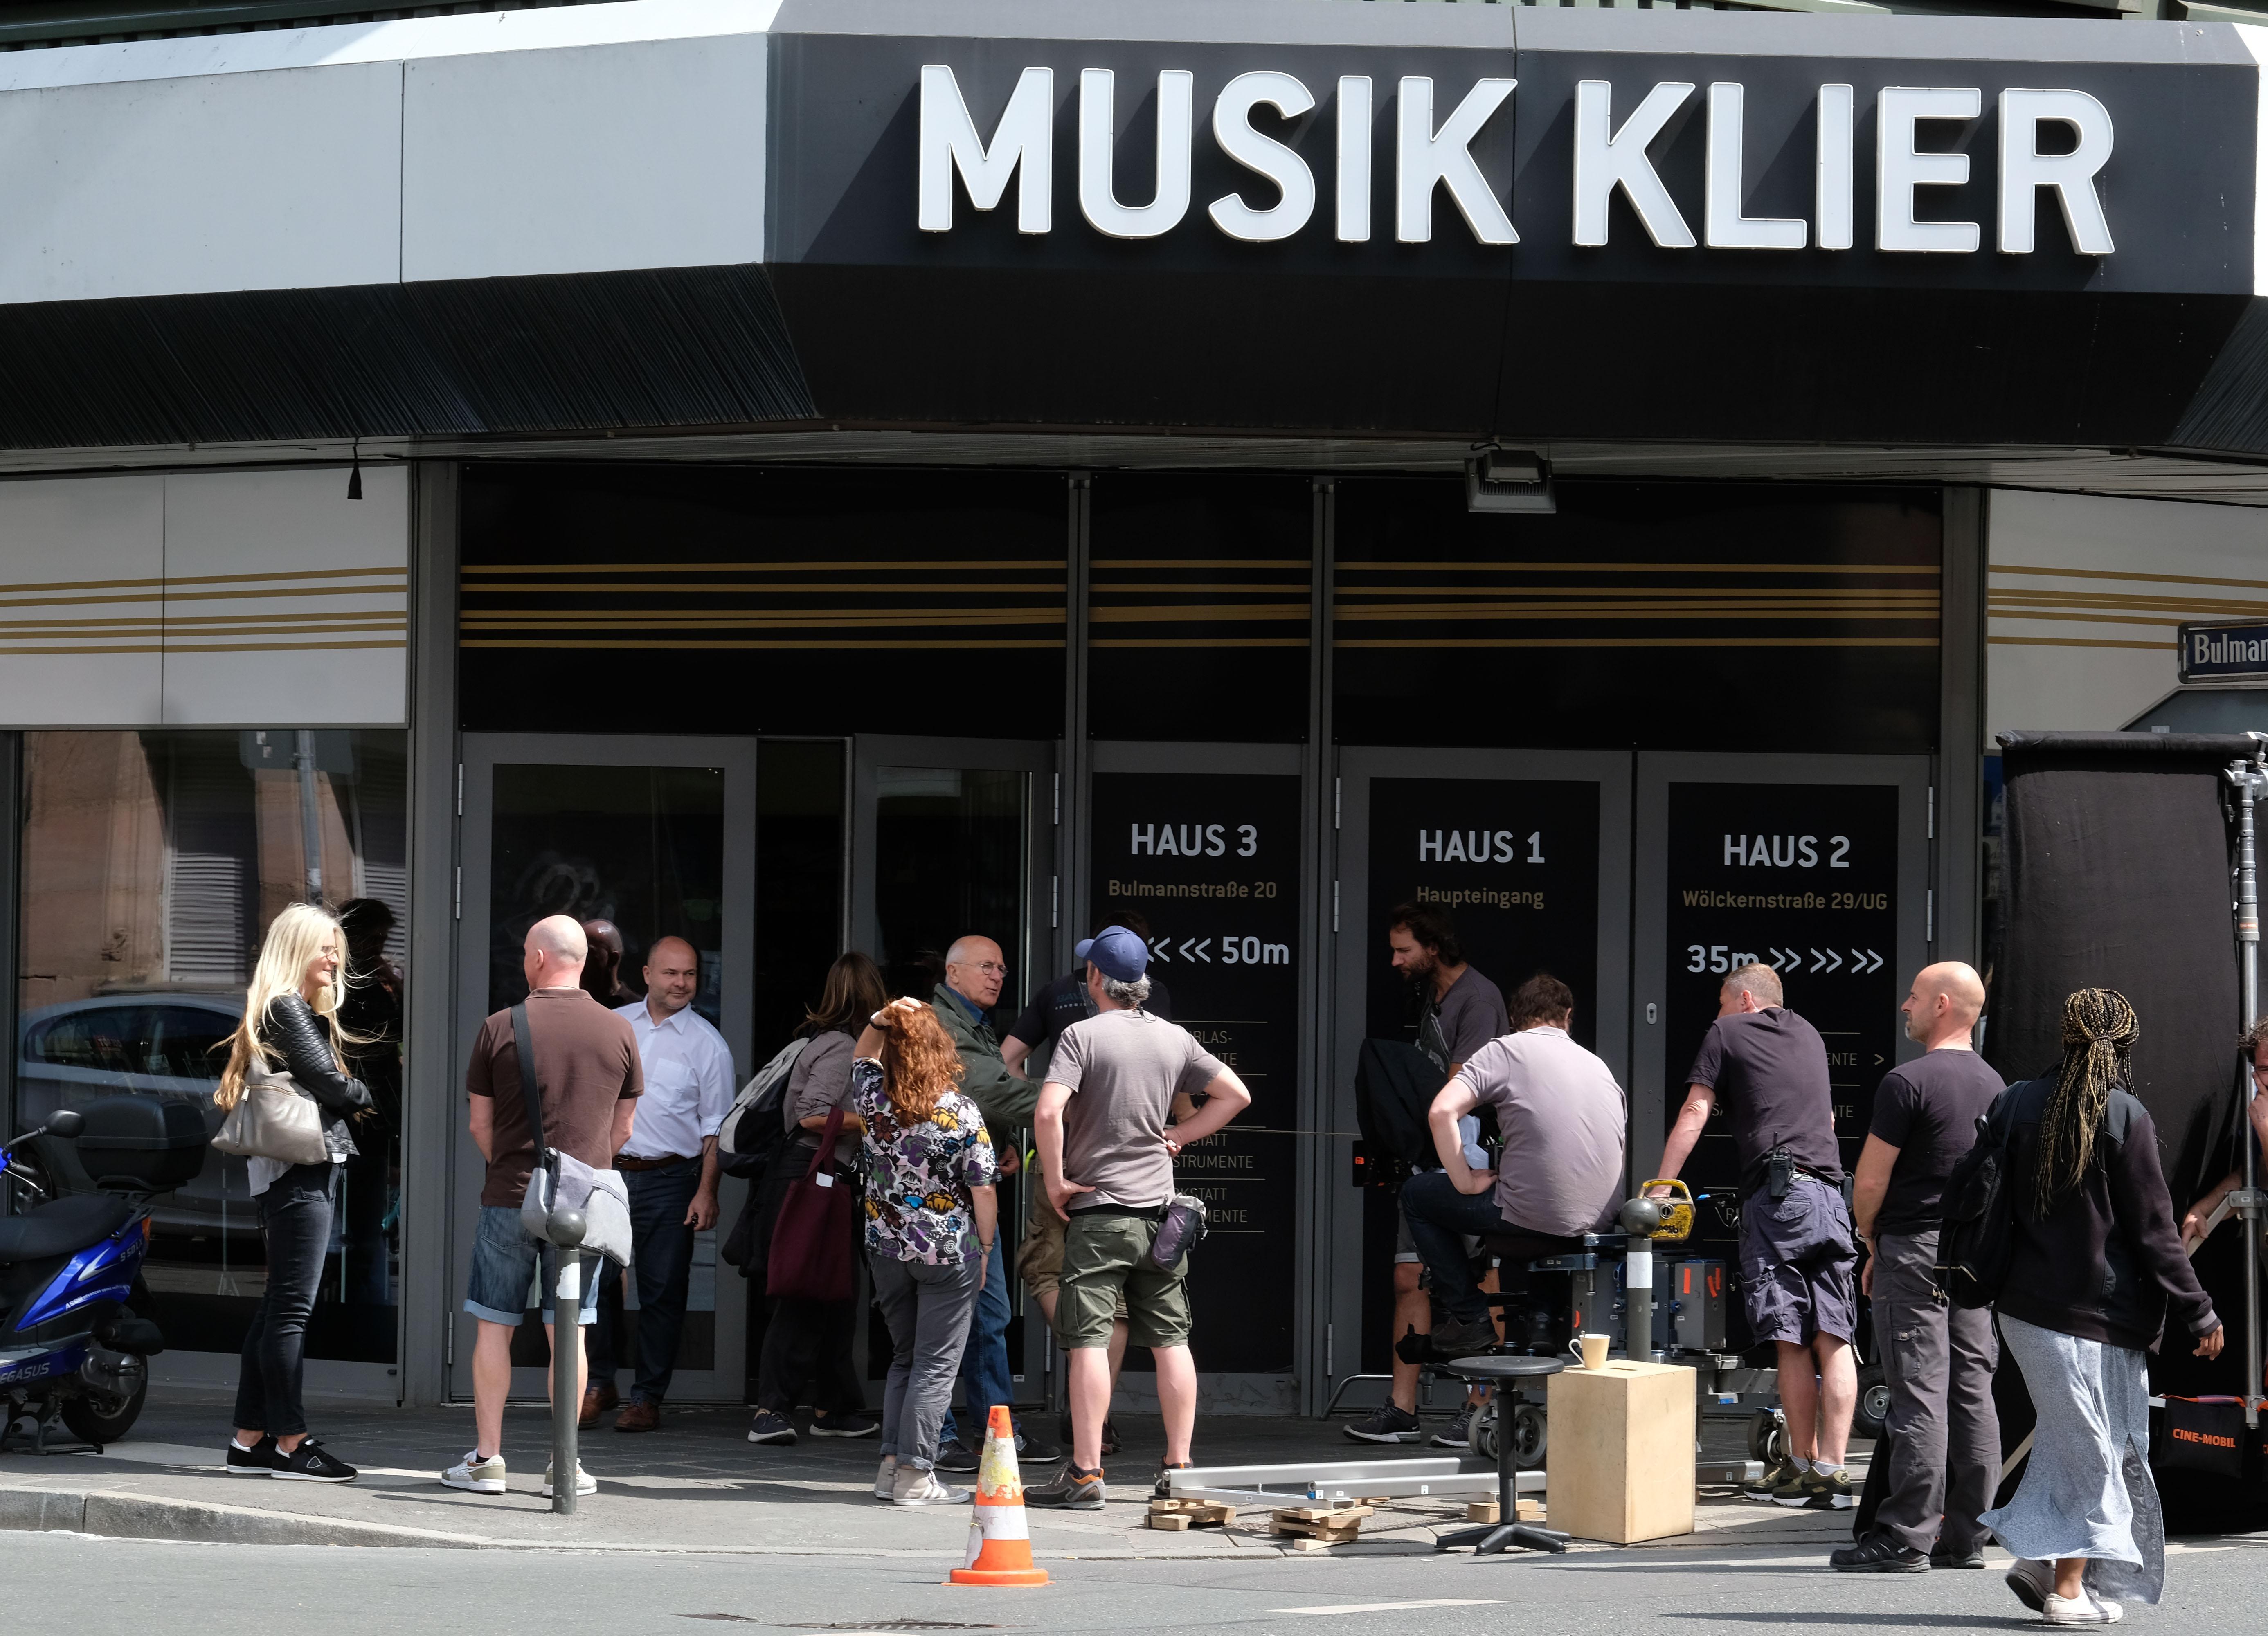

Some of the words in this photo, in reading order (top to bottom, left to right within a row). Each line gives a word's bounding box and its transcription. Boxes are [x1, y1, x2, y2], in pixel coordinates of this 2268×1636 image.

[918, 64, 1521, 245] MUSIK
[1572, 79, 2116, 257] KLIER
[1131, 823, 1226, 856] HAUS
[1237, 824, 1257, 857] 3
[1420, 829, 1514, 863] HAUS
[1527, 831, 1545, 863] 1
[1724, 834, 1818, 867] HAUS
[1830, 836, 1850, 867] 2
[1109, 880, 1249, 898] Bulmannstraße
[1255, 881, 1276, 898] 20
[1417, 886, 1544, 910] Haupteingang
[1683, 890, 1825, 909] Wölckernstraße
[1832, 892, 1888, 910] 29/UG
[1222, 936, 1289, 964] 50m
[1194, 1030, 1232, 1044] BLAS-
[1173, 1155, 1253, 1169] STRUMENTE
[0, 1362, 50, 1384] EGASUS
[2173, 1428, 2236, 1448] CINE-MOBIL
